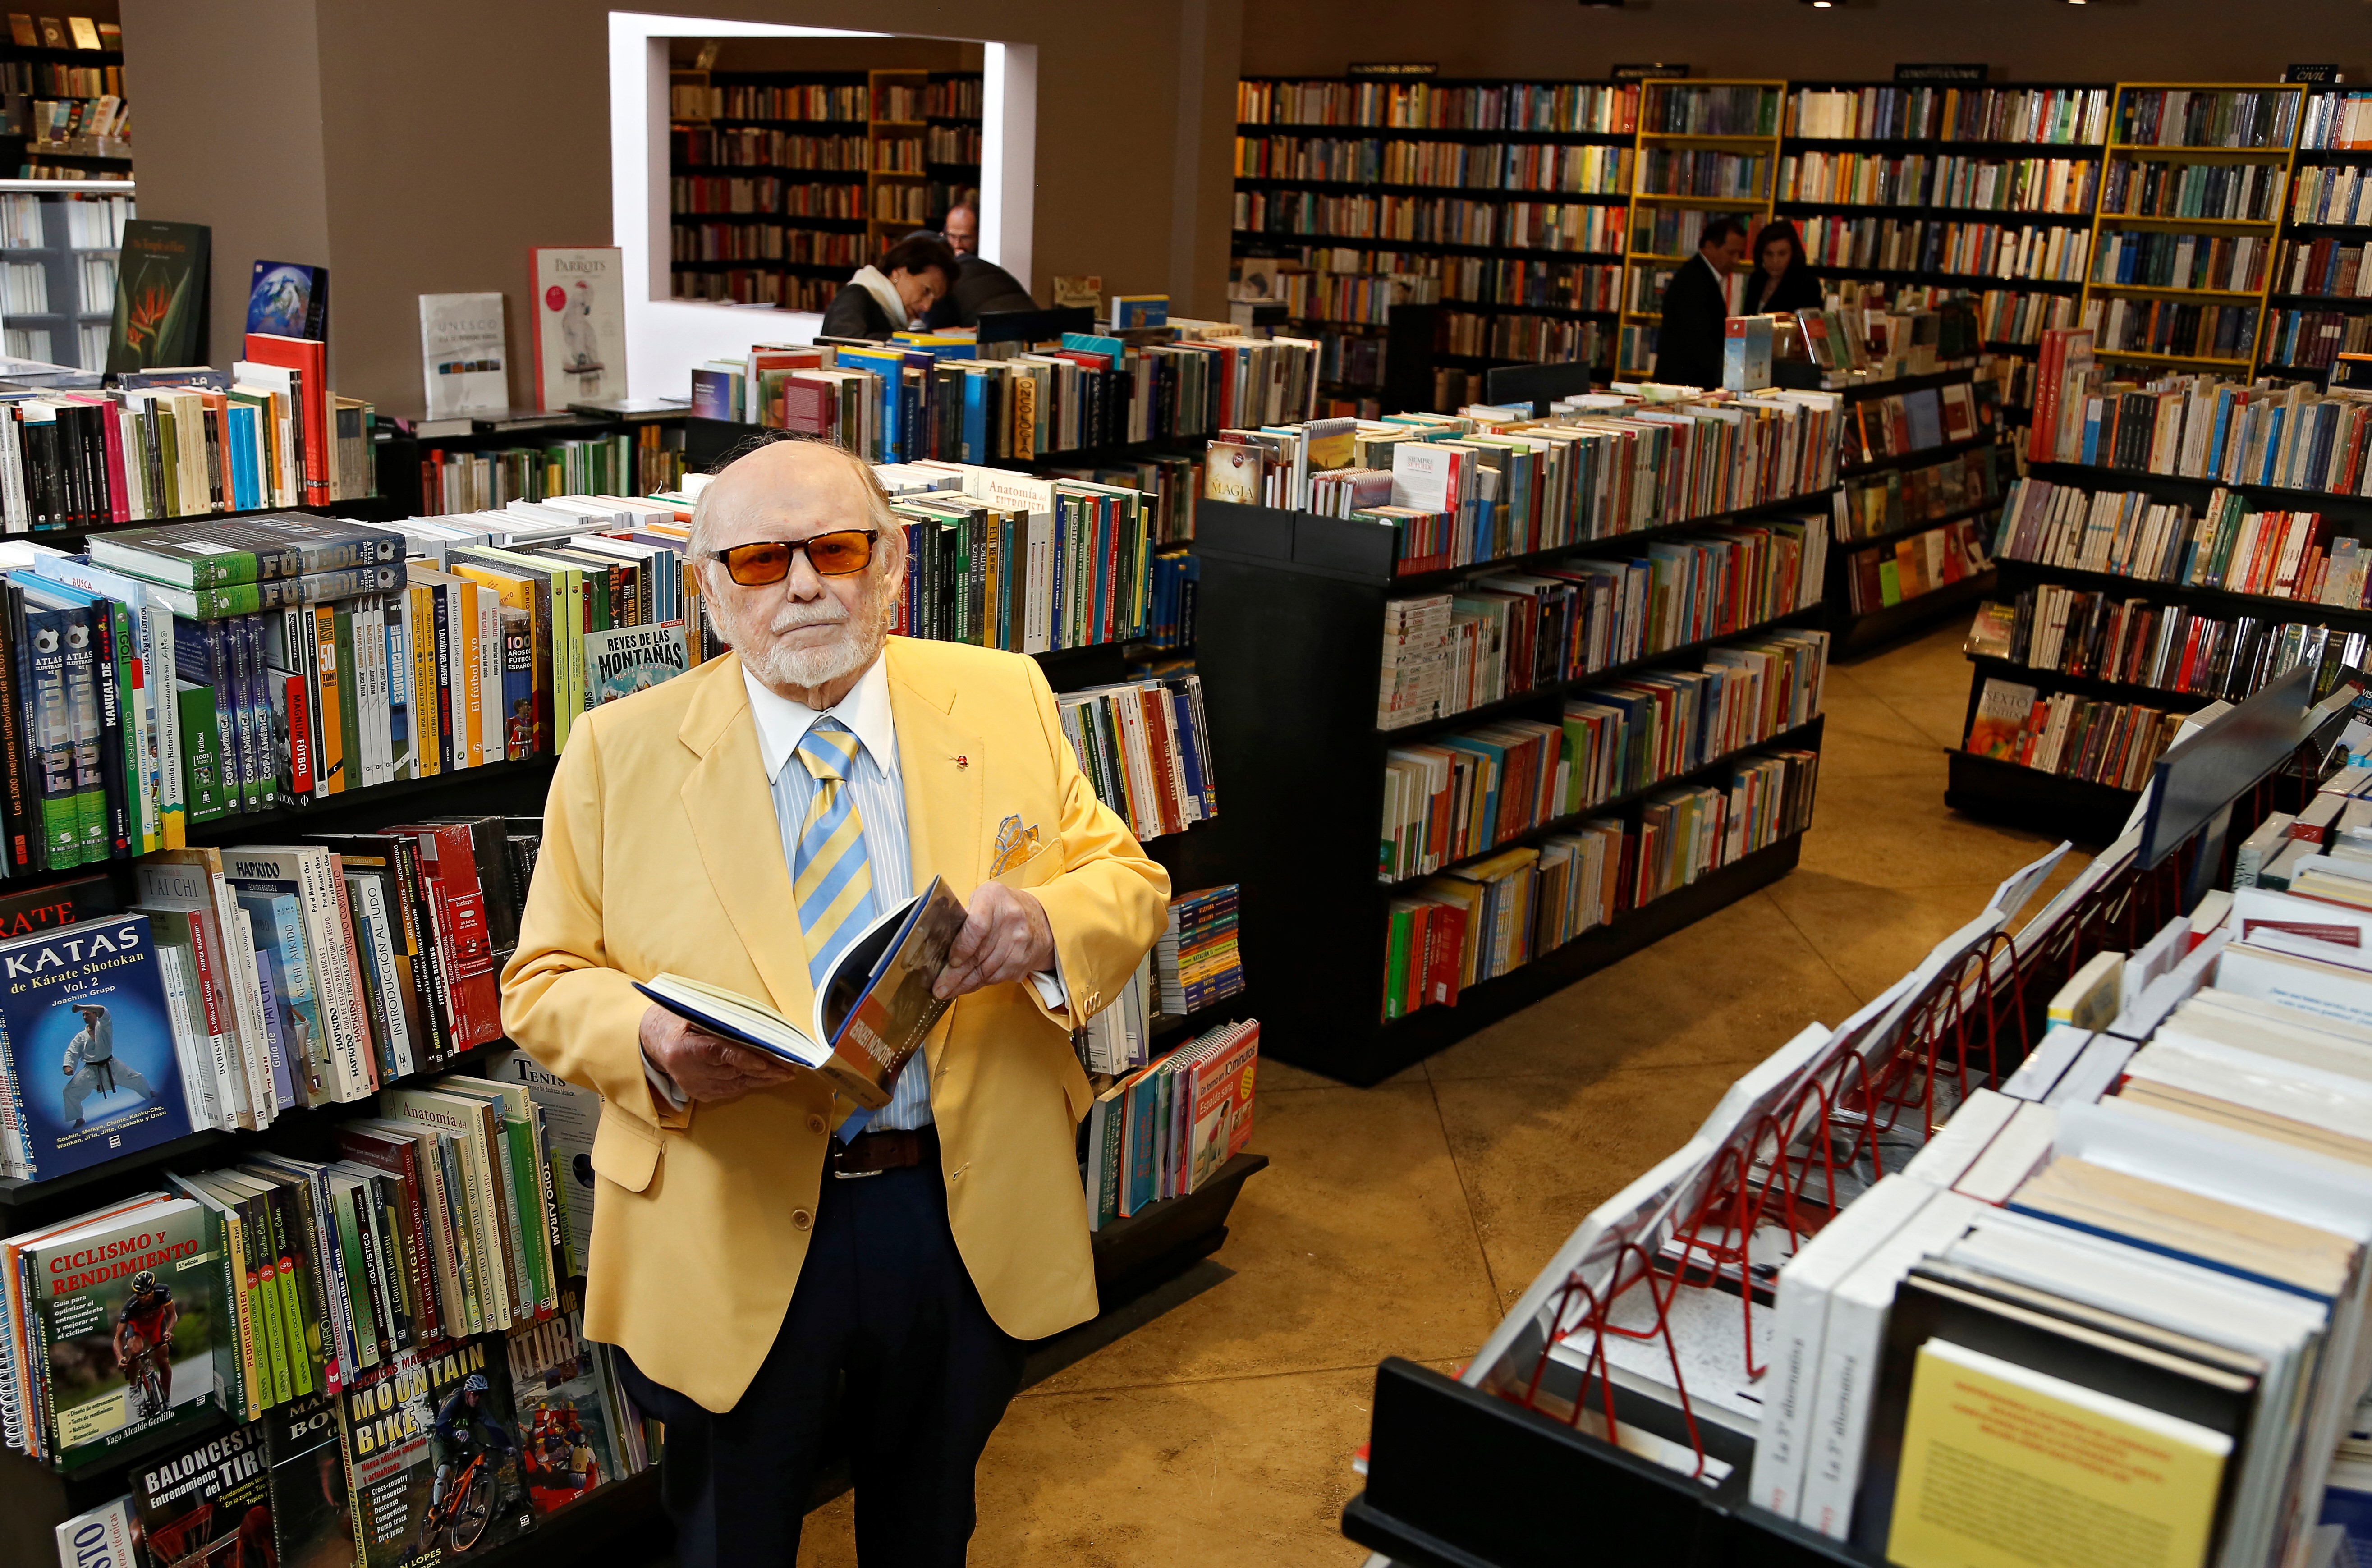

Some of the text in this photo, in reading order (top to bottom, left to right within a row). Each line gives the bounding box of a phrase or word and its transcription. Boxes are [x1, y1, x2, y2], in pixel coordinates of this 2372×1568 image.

[2296, 71, 2325, 81] CIVIL
[555, 258, 606, 272] PARROTS
[438, 319, 497, 332] UNESCO
[1408, 456, 1432, 464] SIEMPRE
[990, 481, 1037, 500] Anatomía
[1212, 481, 1254, 498] MAGIA
[263, 544, 362, 578] FÚTBOL
[72, 578, 92, 590] BUSCA
[265, 572, 361, 606] FÚTBOL
[318, 617, 334, 643] BRASIL
[507, 636, 530, 649] 100
[607, 629, 670, 651] REYES DE LAS
[35, 656, 62, 665] ATLAS
[36, 663, 62, 671] ILUSTRADO
[66, 651, 92, 660] ATLAS
[320, 643, 335, 672] 50
[598, 643, 684, 683] MONTAÑAS
[322, 673, 337, 682] TONI
[391, 653, 405, 703] CIUDADES
[470, 667, 480, 698] fútbol
[101, 662, 116, 727] MANUAL DE
[220, 714, 231, 753] AMÉRICA
[240, 712, 252, 751] AMÉRICA
[259, 709, 269, 747] AMÉRICA
[127, 736, 136, 770] GIFFORD
[7, 742, 22, 816] Los 1000 mejores
[1168, 768, 1177, 800] ESCALADA
[235, 861, 280, 879] HAPKIDO
[394, 844, 411, 922] MARCIALES KICKBOXING
[174, 879, 198, 898] CHI
[334, 870, 348, 923] COMPLETO
[4, 926, 139, 979] KATAS
[285, 924, 298, 960] AIKIDO
[11, 953, 144, 994] de Kárate Shotokan
[197, 951, 206, 971] PATRICK
[367, 886, 403, 1036] INTRODUCCIÓN JUDO
[429, 946, 440, 974] BOXING
[52, 985, 115, 1007] Joachim Grupp
[64, 977, 99, 993] Vol. 2
[324, 977, 344, 1052] HAPKIDO TÉCNICAS
[213, 1036, 225, 1075] BUBISHI
[272, 1045, 280, 1068] Guía
[346, 1033, 358, 1078] HAPKIDO
[513, 1058, 567, 1087] TENIS
[1201, 1086, 1206, 1096] En
[1207, 1077, 1218, 1090] forma
[1219, 1073, 1224, 1082] en
[1200, 1082, 1234, 1115] Espalda sana
[403, 1101, 467, 1129] Anatomía del
[56, 1111, 166, 1149] Wankan, Gankaku Unsu
[56, 1132, 81, 1143] Sochin,
[467, 1175, 477, 1206] SWING
[542, 1162, 561, 1246] TODO AJRAM
[49, 1231, 167, 1274] CICLISMO Y
[408, 1233, 420, 1285] TIGER
[51, 1239, 198, 1296] RENDIMIENTO
[53, 1295, 87, 1308] Guía para
[55, 1303, 87, 1316] optimizar
[55, 1306, 104, 1324] entrenamiento
[62, 1319, 89, 1331] mejorar
[66, 1325, 94, 1338] ciclismo
[239, 1290, 253, 1368] PEDALEAR BIEN
[352, 1342, 485, 1421] MOUNTAIN
[106, 1411, 174, 1446] Yago Alcalde Gordillo
[356, 1405, 418, 1455] BIKE
[361, 1437, 427, 1472] Nueva edición ampliada
[368, 1462, 400, 1482] actualizada
[372, 1474, 408, 1496] Cross-country
[150, 1469, 217, 1509] Entrenamiento
[205, 1481, 220, 1498] del
[219, 1481, 254, 1503] Fundamentos
[382, 1485, 407, 1503] mountain
[374, 1499, 399, 1515] Descenso
[375, 1504, 408, 1524] Competición
[377, 1514, 408, 1533] Pump track
[378, 1526, 404, 1543] Dirt jump
[411, 1548, 442, 1567] LOPES
